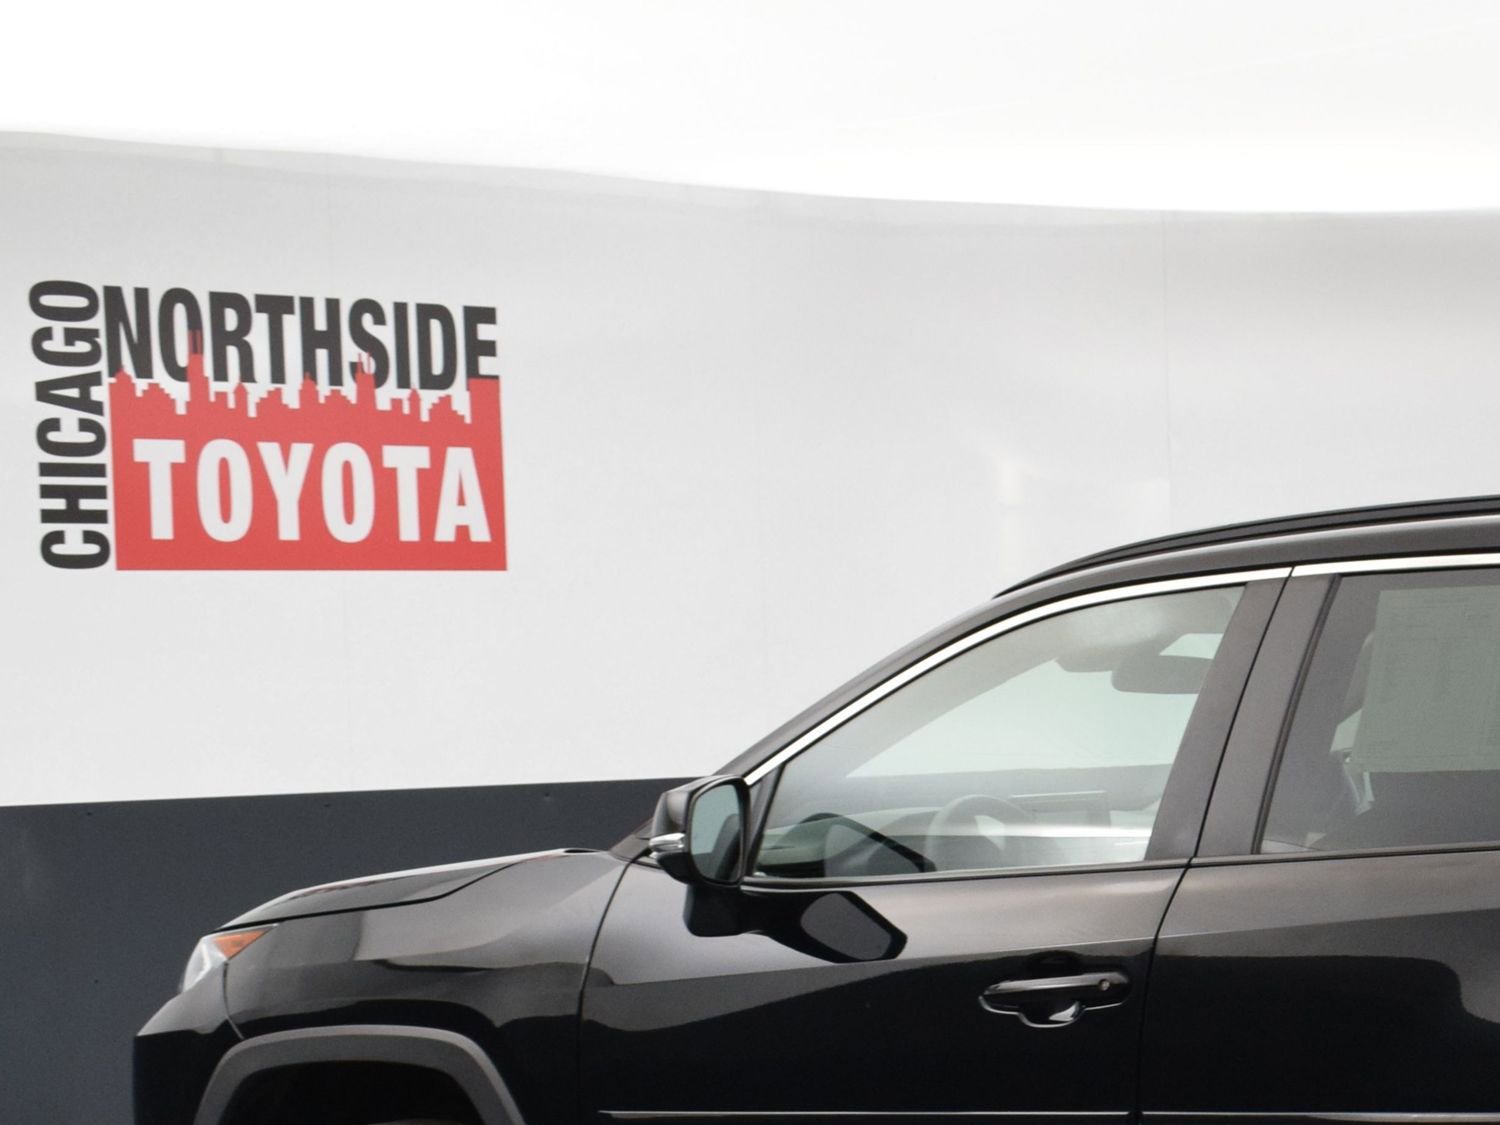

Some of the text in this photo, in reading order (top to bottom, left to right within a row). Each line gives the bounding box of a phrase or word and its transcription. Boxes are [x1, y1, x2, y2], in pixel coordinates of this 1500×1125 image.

[103, 284, 500, 392] NORTHSIDE
[28, 279, 112, 570] CHICAGO
[133, 437, 492, 543] TOYOTA
